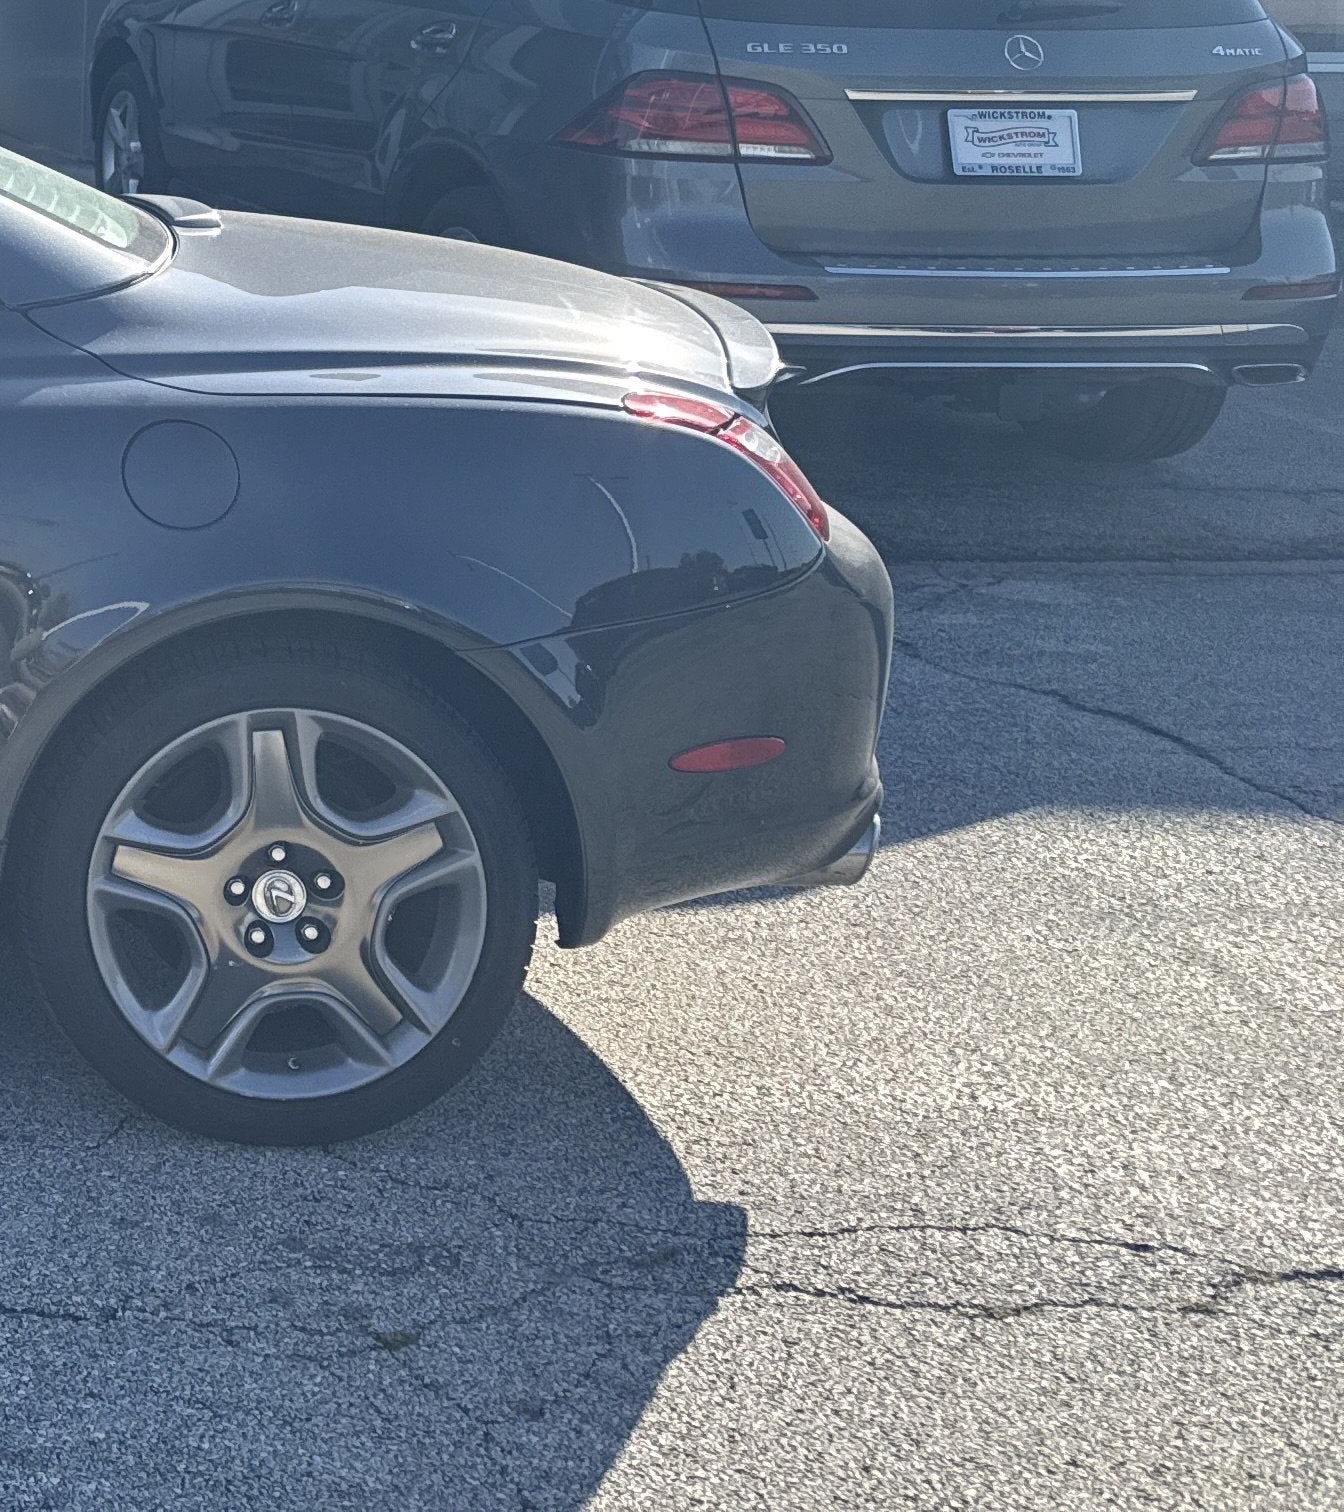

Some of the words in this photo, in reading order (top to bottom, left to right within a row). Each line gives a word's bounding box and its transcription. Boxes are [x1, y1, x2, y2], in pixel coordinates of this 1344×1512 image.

[746, 42, 793, 53] GLE
[800, 43, 848, 54] 350
[1212, 45, 1263, 56] 4MATIC
[977, 110, 1046, 120] WICKSTROM
[976, 131, 1046, 144] WICKSTROM
[990, 165, 1043, 175] ROSELLE
